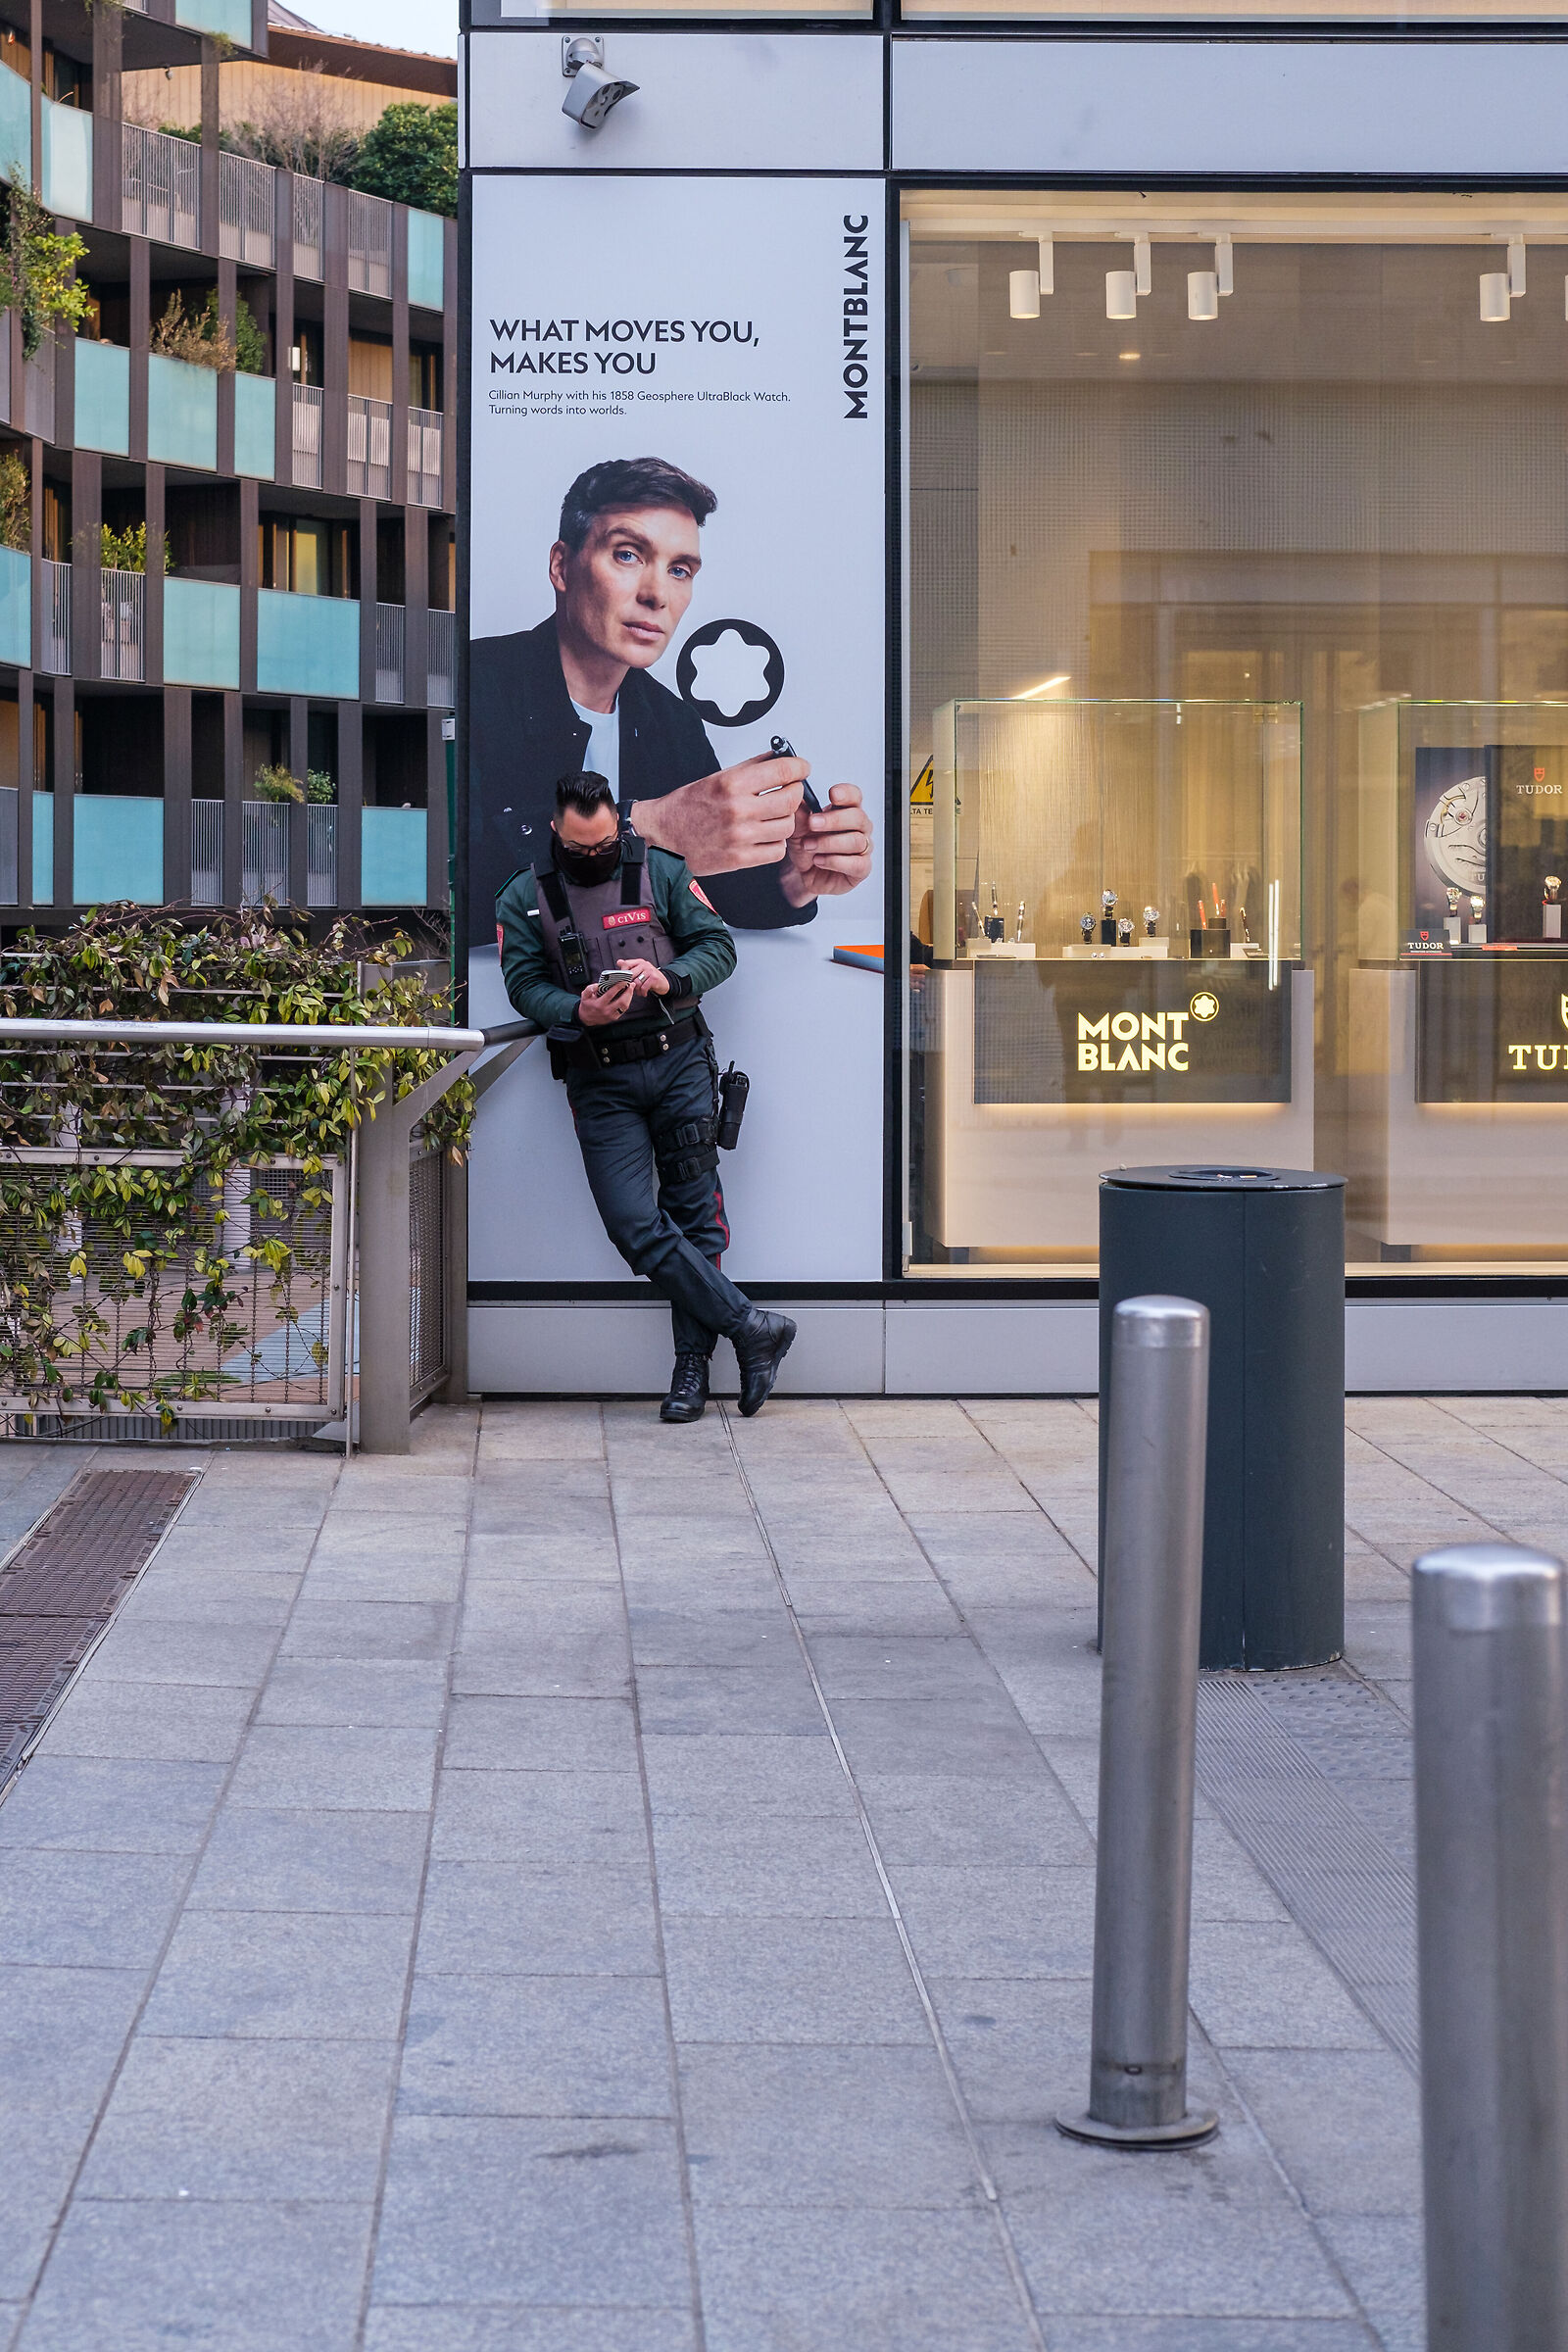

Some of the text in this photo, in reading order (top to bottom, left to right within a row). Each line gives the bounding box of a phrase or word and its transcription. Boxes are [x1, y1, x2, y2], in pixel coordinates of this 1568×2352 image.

[842, 215, 869, 419] MONTBLANC
[489, 318, 760, 348] WHAT MOVES YOU,
[490, 351, 656, 374] MAKES YOU
[488, 389, 791, 404] Cillian Murphy with his 1858 Geosphere UltraBlack Watch.
[488, 404, 627, 417] Turning words into worlds.
[1516, 784, 1563, 795] TUDOR
[1077, 1011, 1190, 1042] MONT
[1077, 1042, 1190, 1072] BLANC
[1508, 1044, 1568, 1071] TU
